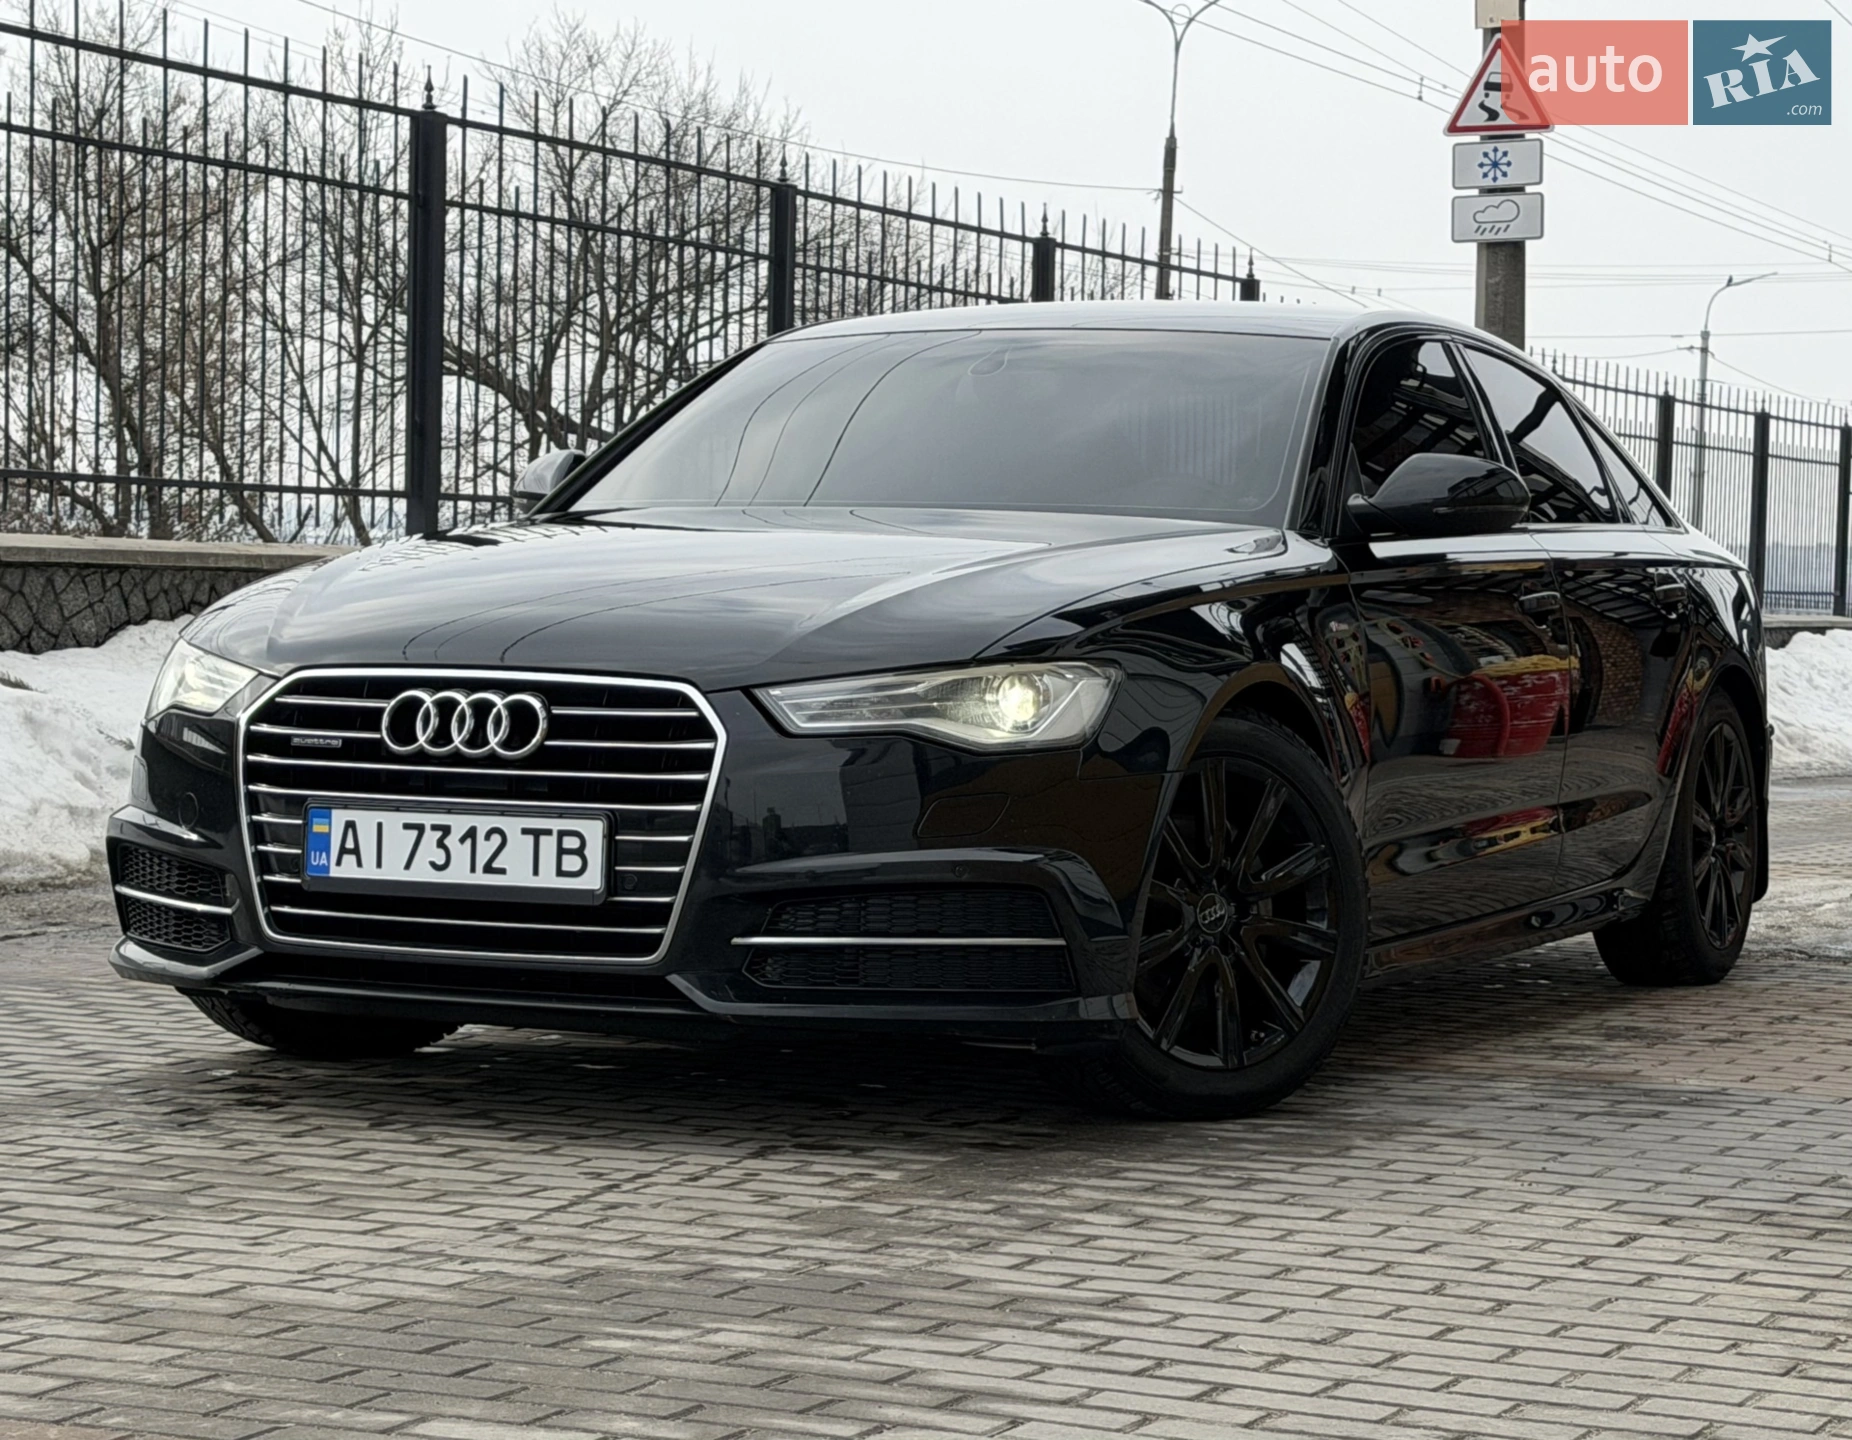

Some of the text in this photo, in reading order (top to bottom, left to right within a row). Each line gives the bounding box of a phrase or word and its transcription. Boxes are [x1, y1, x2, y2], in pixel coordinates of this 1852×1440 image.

[310, 850, 328, 867] UA
[335, 819, 588, 878] AI 7312 TB
